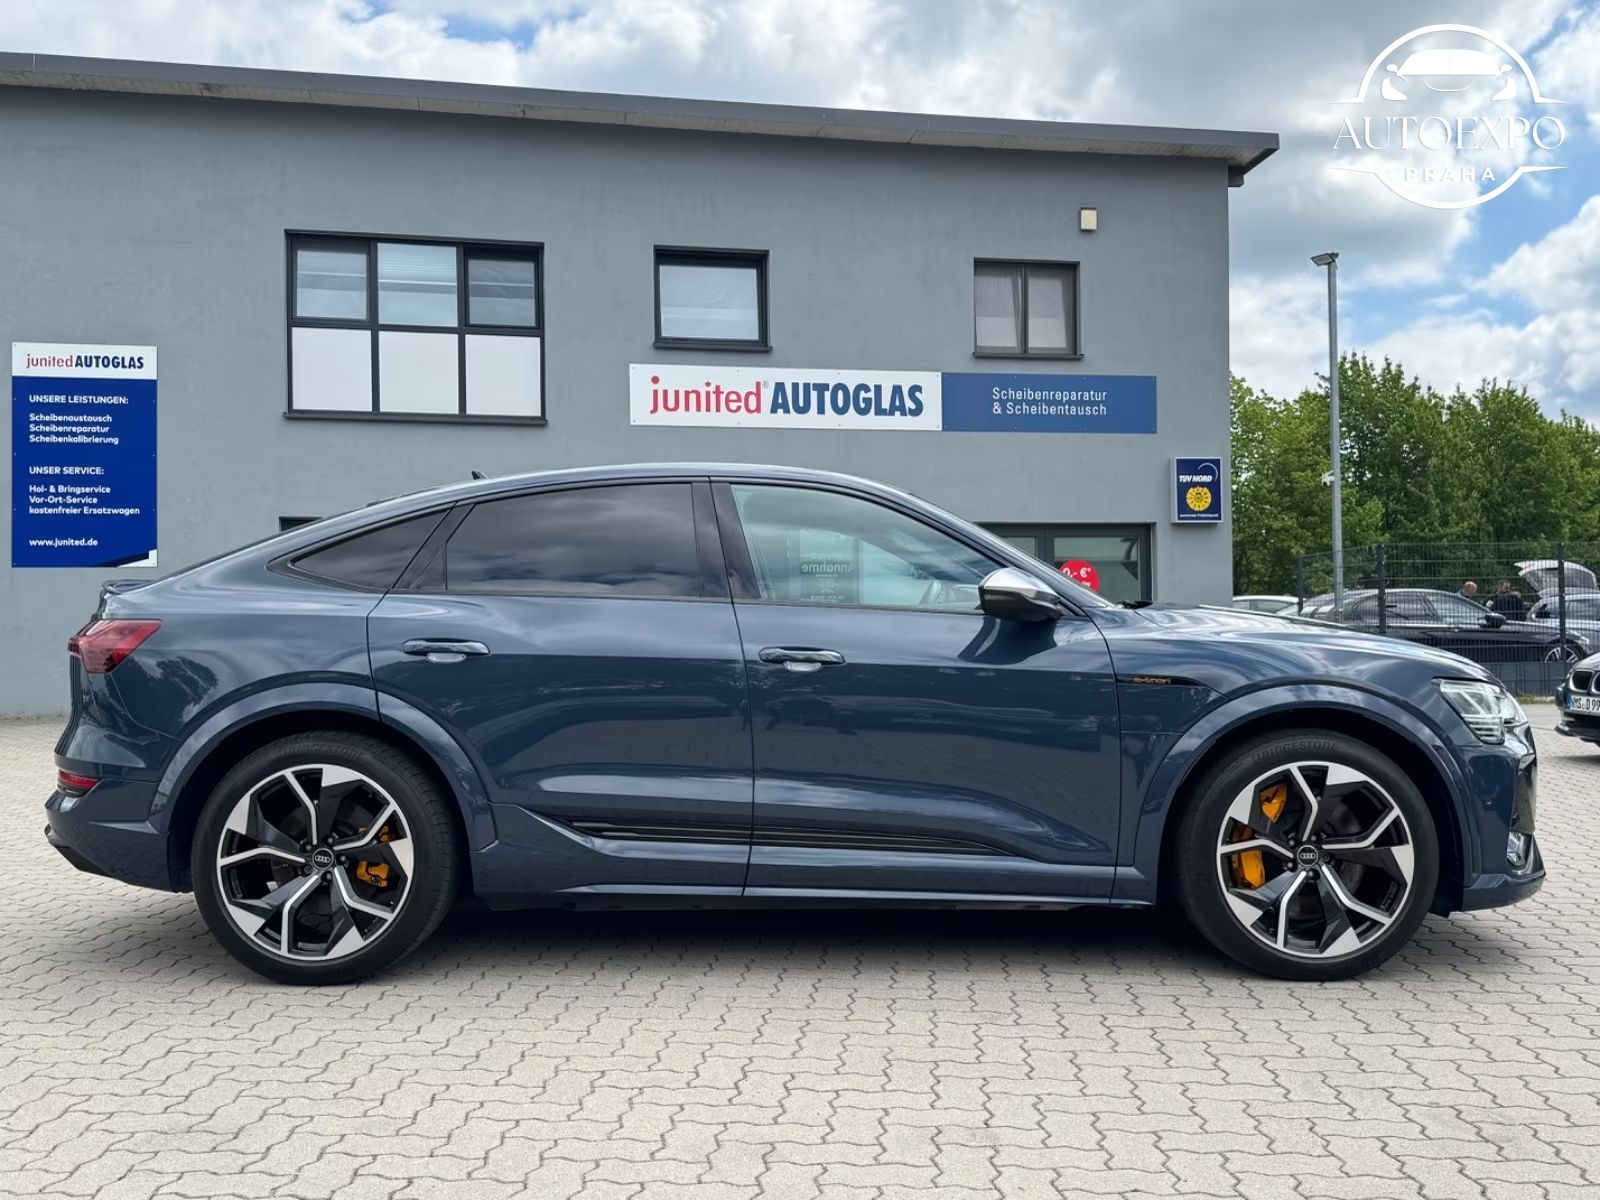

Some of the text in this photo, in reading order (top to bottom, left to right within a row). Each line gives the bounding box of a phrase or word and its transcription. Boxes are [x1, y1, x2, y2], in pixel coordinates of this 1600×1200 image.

[26, 354, 144, 369] junited AUTOGLAS
[29, 395, 129, 405] UNSERE LEISTUNGEN:
[770, 382, 923, 417] AUTOGLAS
[992, 387, 1107, 403] Scheibenreparatur
[992, 402, 1107, 416] & Scheibentausch
[29, 413, 112, 423] Scheibenaustausch
[29, 424, 110, 434] Scheibenreparatur
[29, 434, 119, 445] Scheibenkalibrierung
[29, 466, 104, 475] UNSER SERVICE:
[29, 485, 111, 494] Hol- & Bringservice
[29, 496, 98, 504] Vor-Ort-Service
[29, 506, 140, 516] kostenfreier Ersatzwagen
[29, 538, 98, 547] www.junited.de
